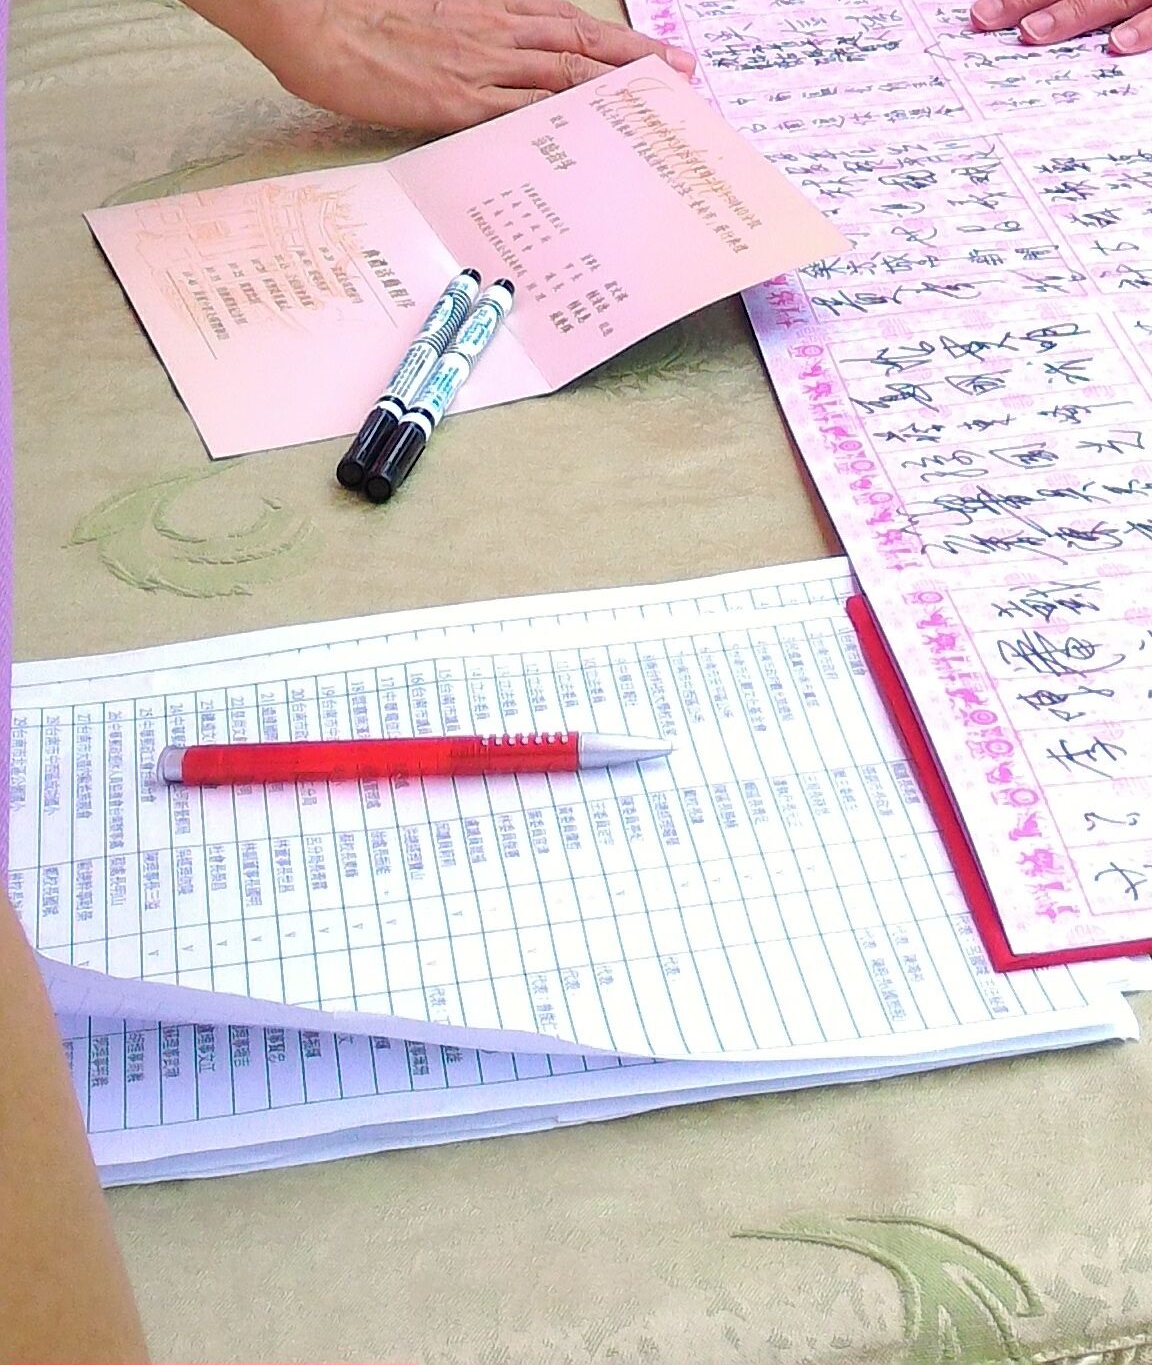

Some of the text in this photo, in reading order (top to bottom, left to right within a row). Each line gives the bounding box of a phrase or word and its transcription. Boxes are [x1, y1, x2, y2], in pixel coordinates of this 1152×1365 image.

[360, 248, 417, 310] 典禮活動程序
